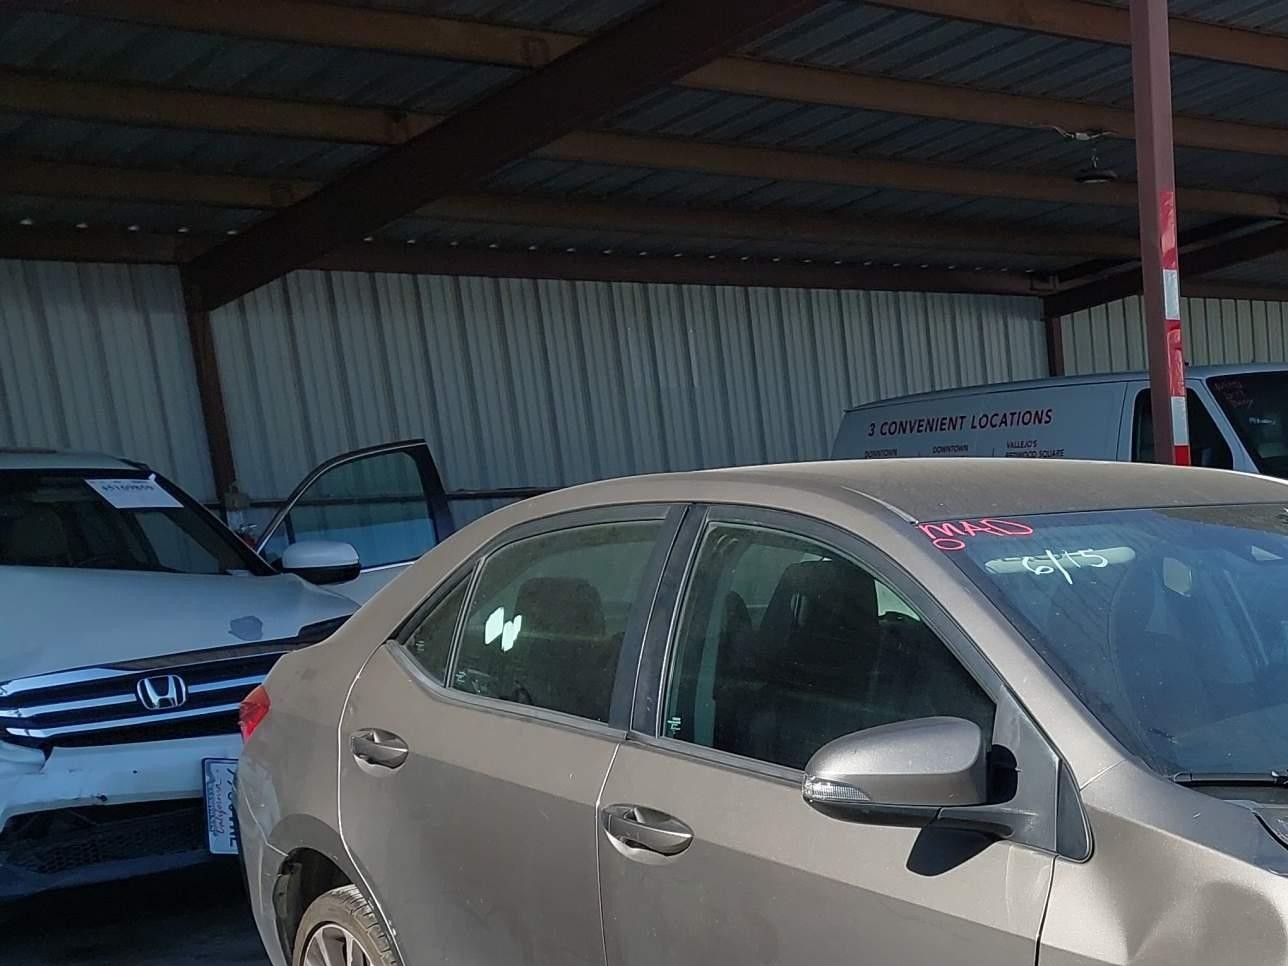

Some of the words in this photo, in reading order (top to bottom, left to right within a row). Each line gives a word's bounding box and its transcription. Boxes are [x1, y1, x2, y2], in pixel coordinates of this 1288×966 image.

[867, 423, 876, 437] 3
[879, 415, 967, 436] CONVENIENT
[970, 408, 1053, 429] LOCATIONS
[932, 444, 969, 454] DOWNTOWN
[1038, 448, 1065, 458] SQUARE
